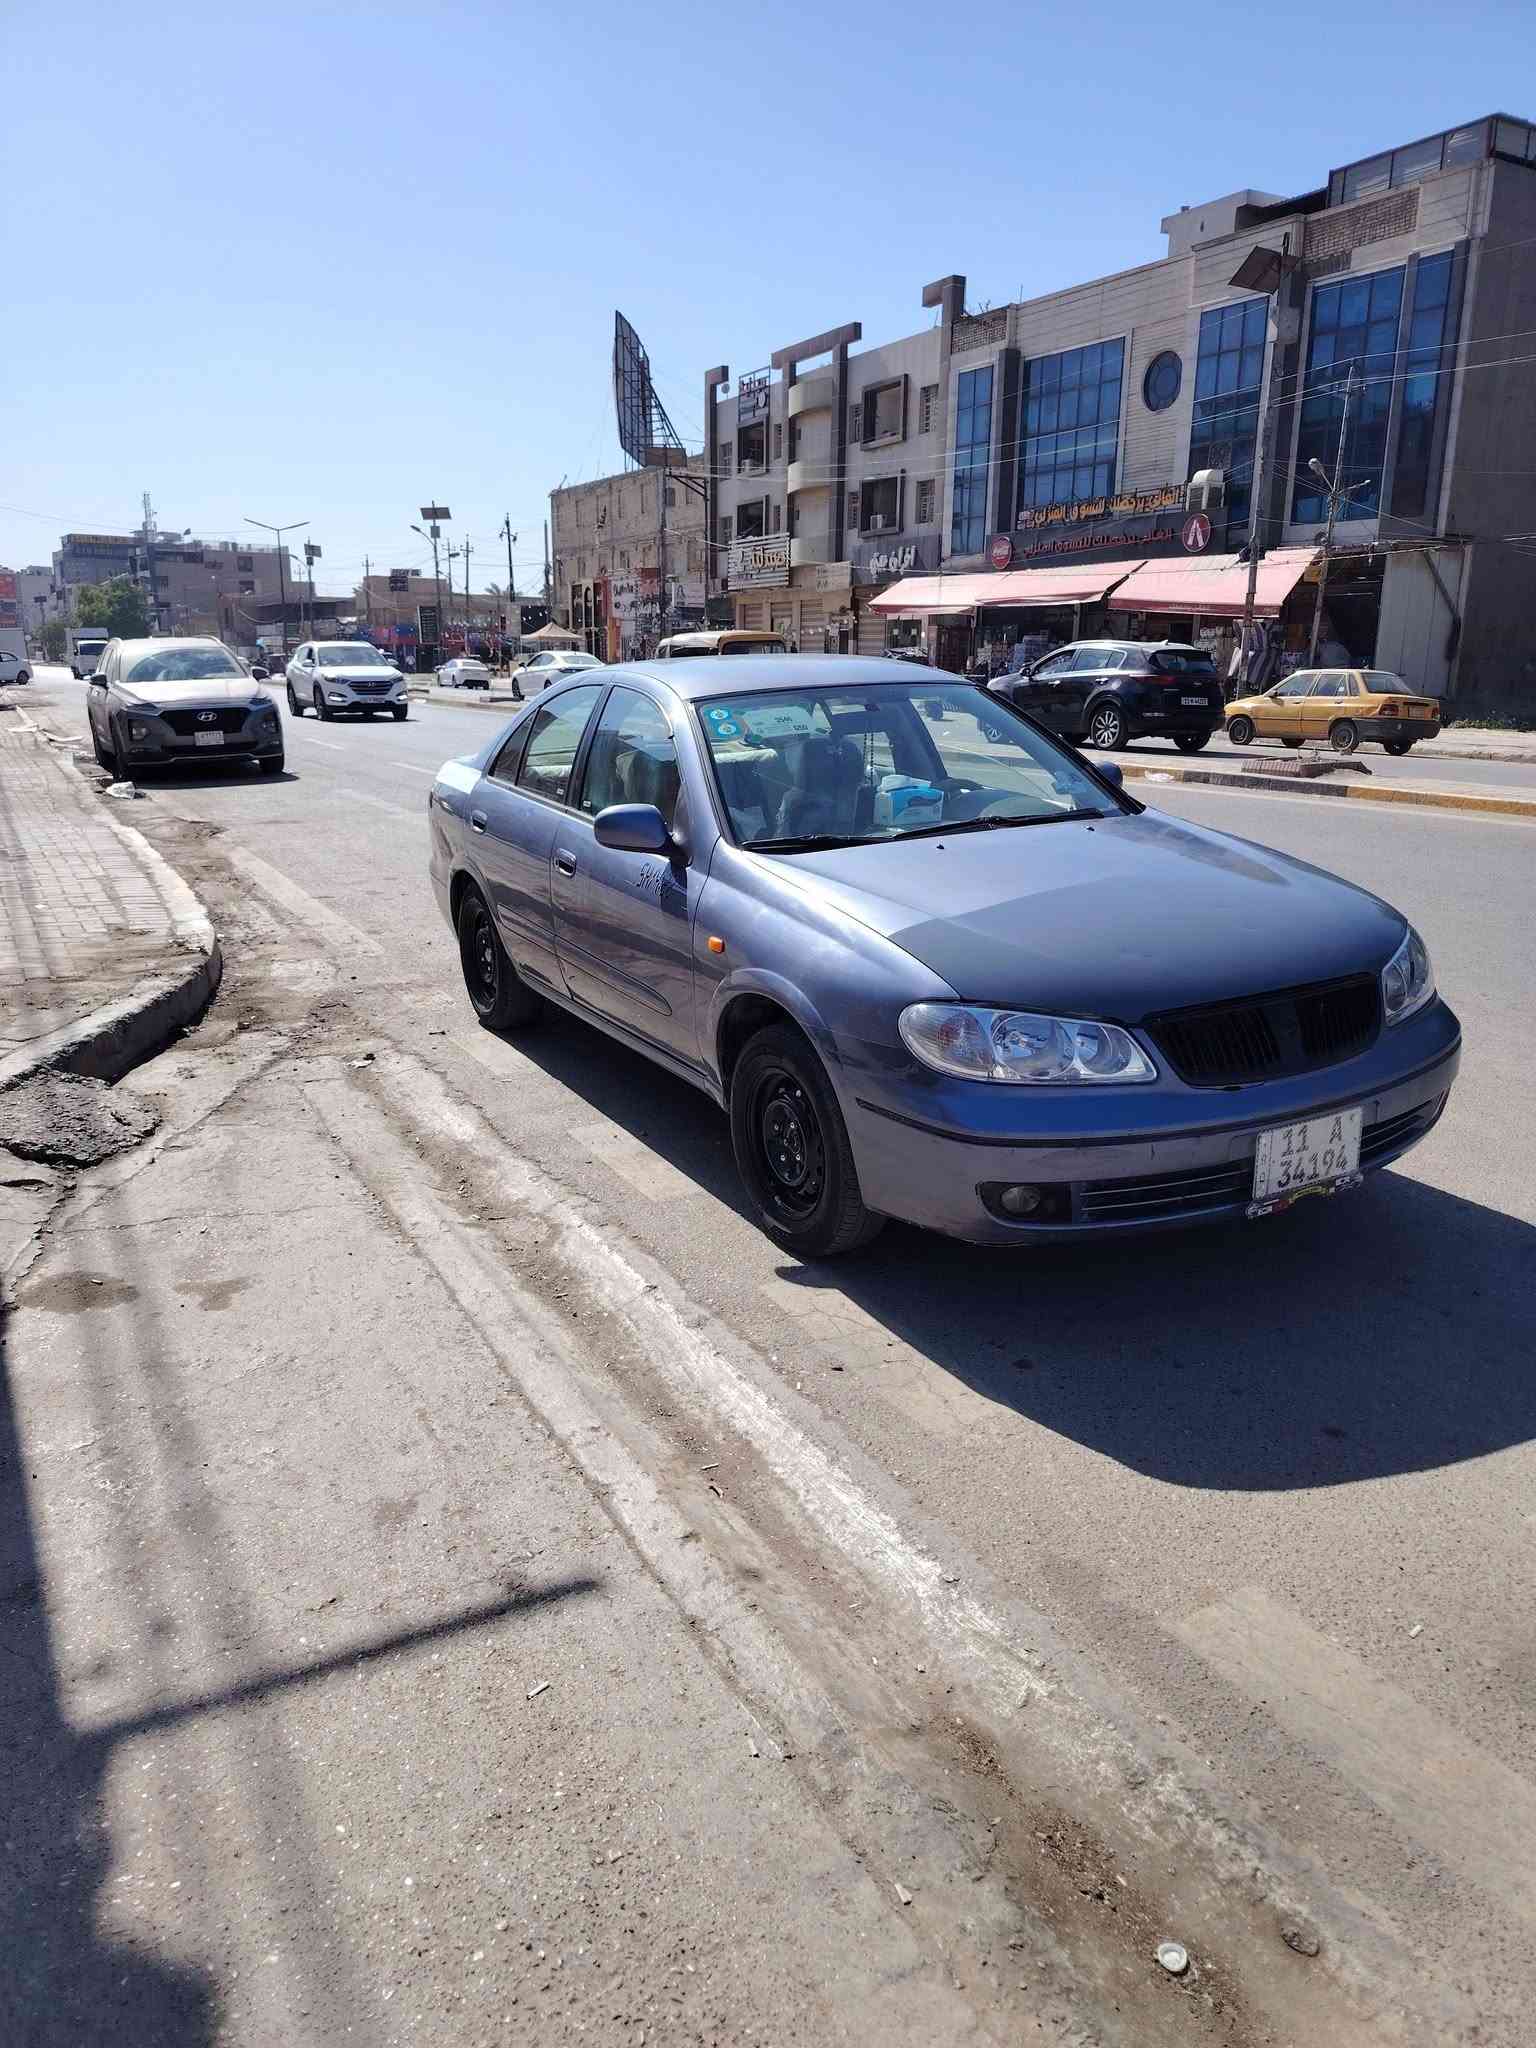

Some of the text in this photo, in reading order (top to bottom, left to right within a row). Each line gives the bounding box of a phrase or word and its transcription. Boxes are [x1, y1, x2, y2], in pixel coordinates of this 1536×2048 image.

[752, 546, 785, 573] صيدلية
[1281, 1116, 1343, 1157] 11 A
[1278, 1144, 1348, 1188] 34194
